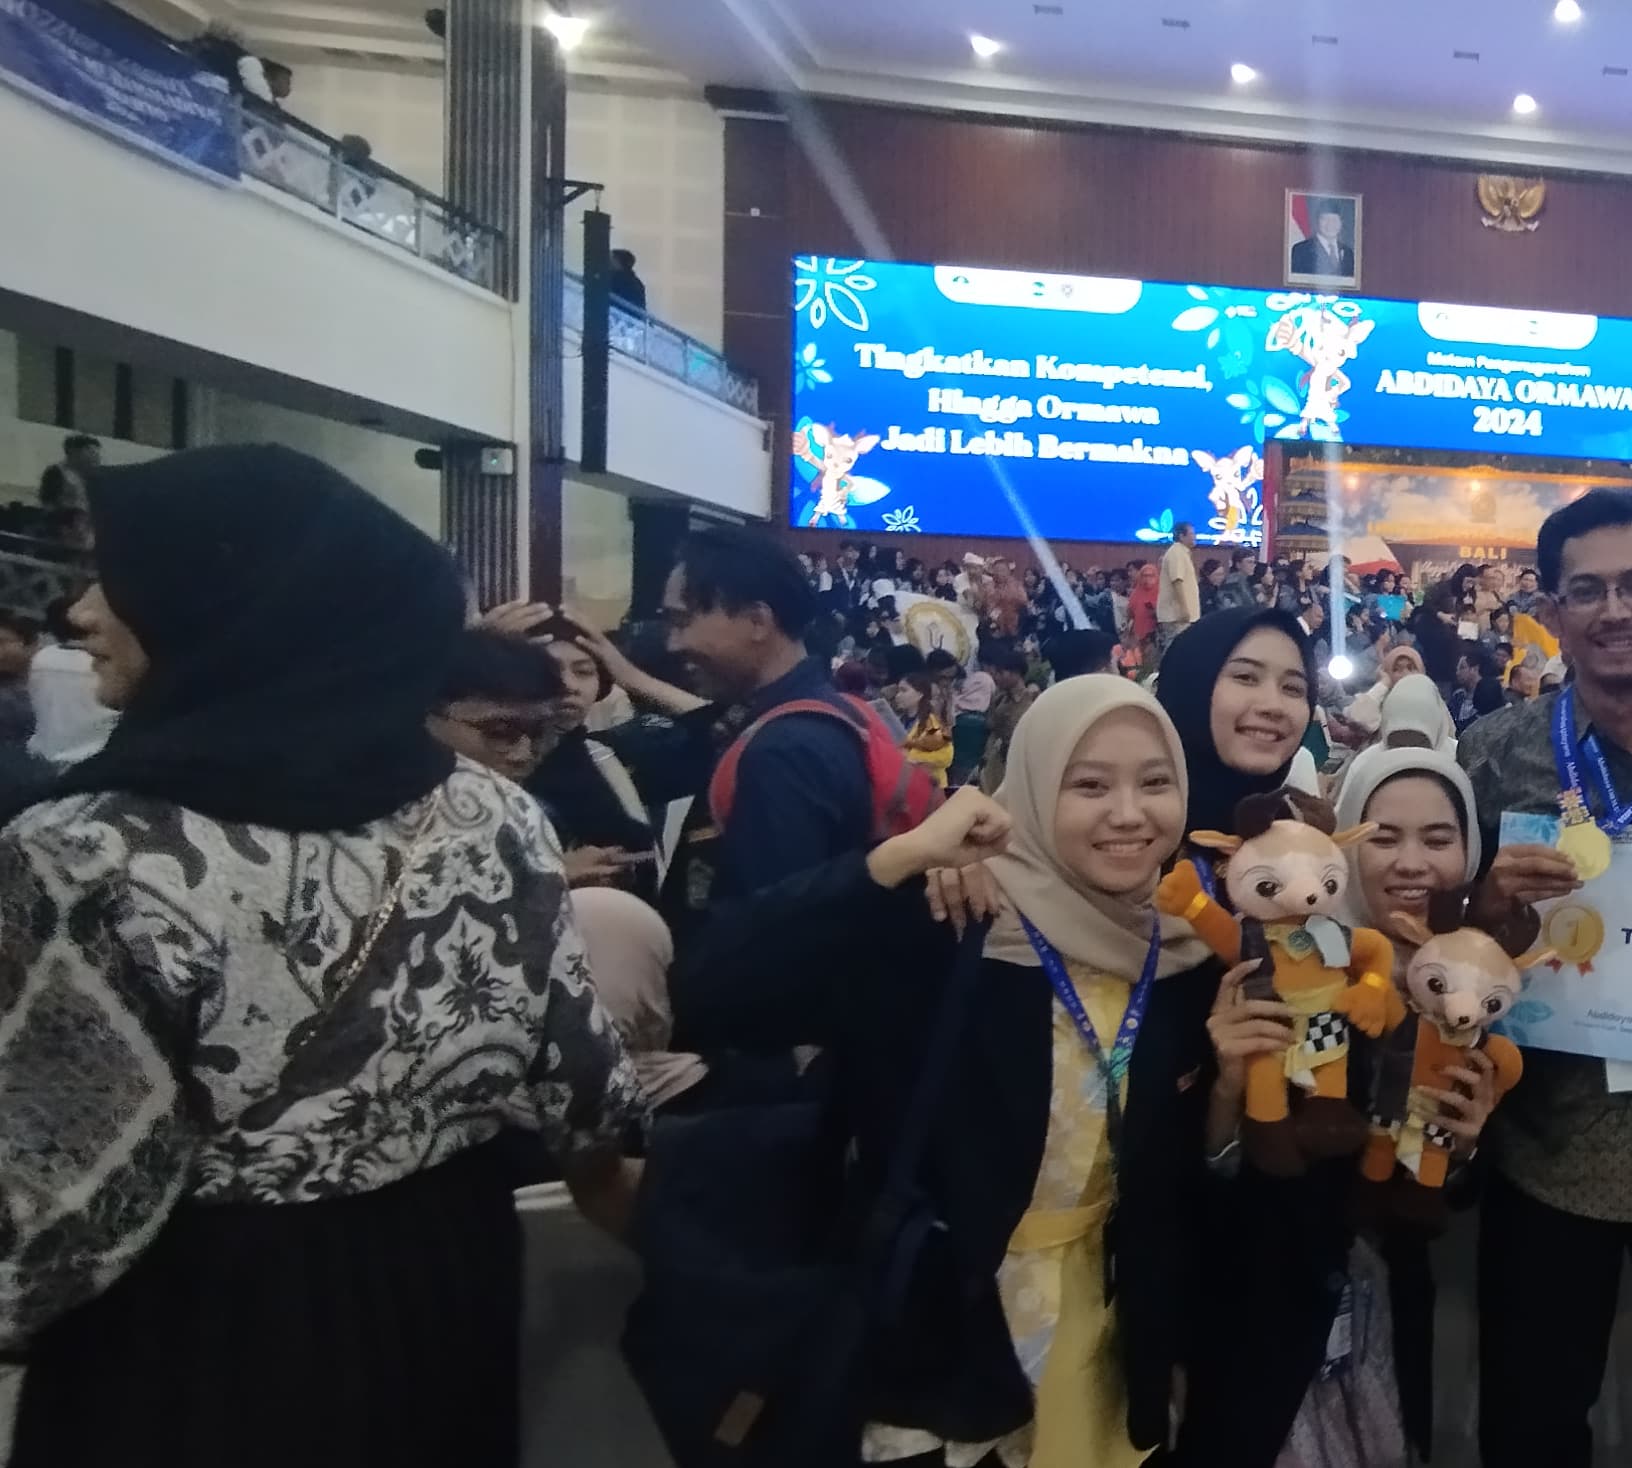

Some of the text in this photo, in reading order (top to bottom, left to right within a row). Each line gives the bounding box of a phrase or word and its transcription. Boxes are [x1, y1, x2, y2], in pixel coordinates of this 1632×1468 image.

[854, 342, 1030, 379] Tingkatkan
[1376, 370, 1512, 403] ABDIDAYA
[928, 387, 1160, 426] Hingga Ormawa
[1473, 407, 1543, 437] 2024
[881, 426, 1190, 467] Jadi Lebih Bermakna
[1459, 546, 1508, 560] BALI
